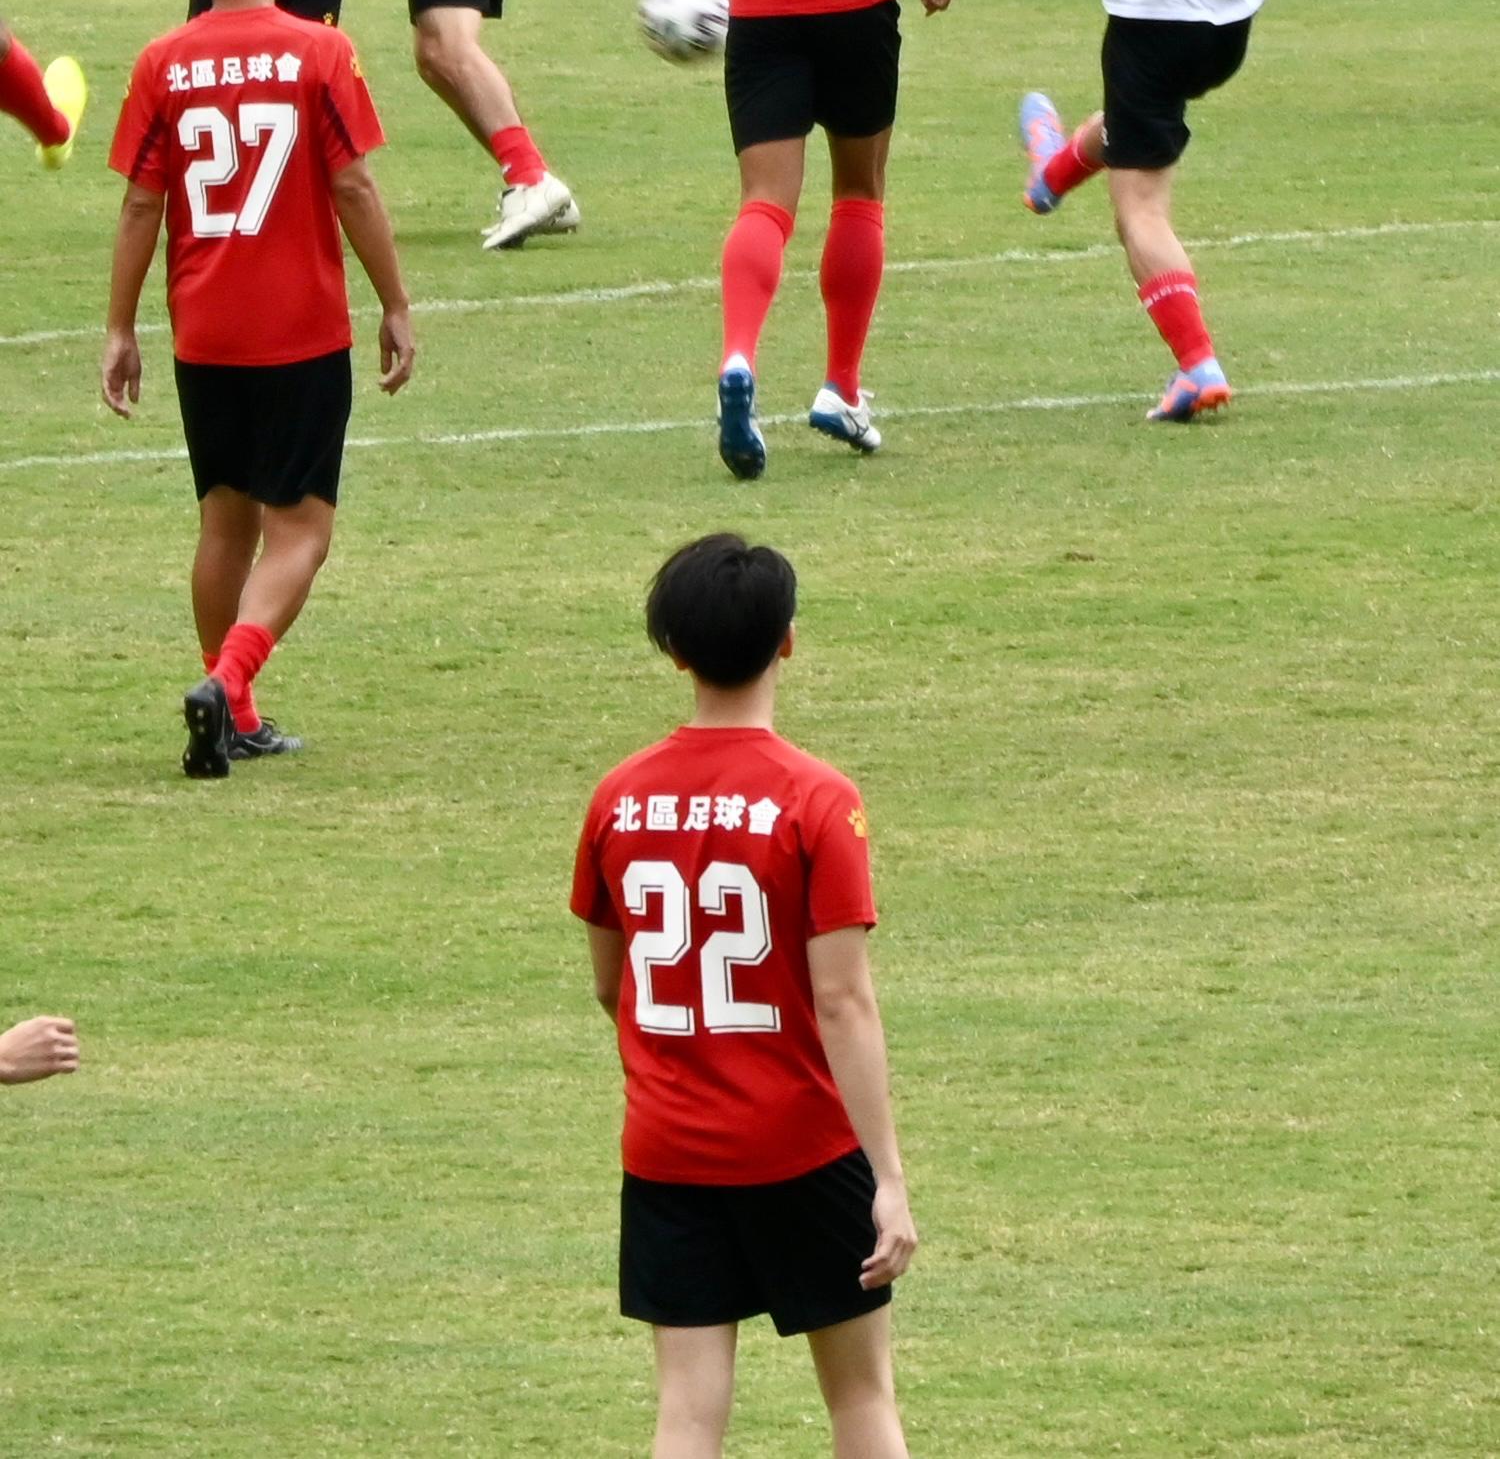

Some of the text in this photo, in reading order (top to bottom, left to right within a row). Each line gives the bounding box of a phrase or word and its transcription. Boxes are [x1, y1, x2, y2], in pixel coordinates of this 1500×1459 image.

[166, 52, 302, 92] 北區足球會
[177, 102, 299, 239] 27
[612, 793, 782, 836] 北區足球會
[621, 860, 782, 1036] 22
